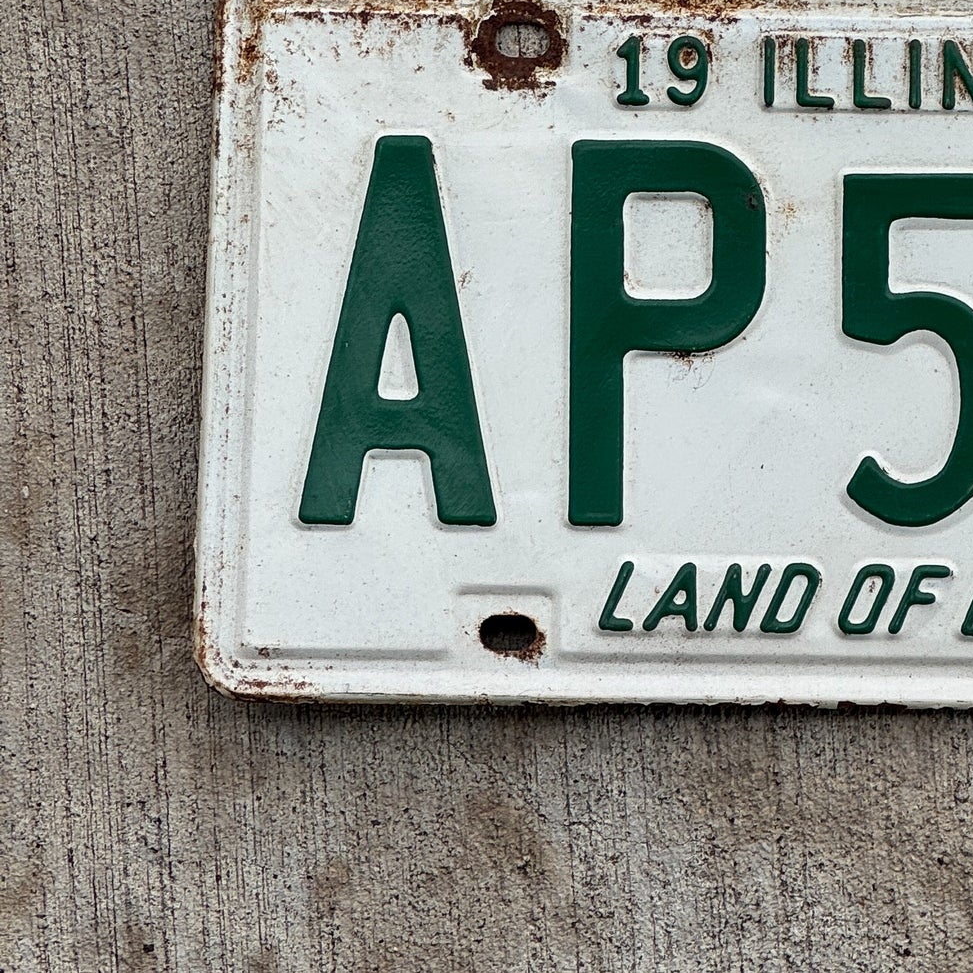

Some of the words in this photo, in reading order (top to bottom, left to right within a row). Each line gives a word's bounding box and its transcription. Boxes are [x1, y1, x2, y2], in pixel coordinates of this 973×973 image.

[616, 34, 709, 106] 19
[598, 559, 821, 634] LAND
[836, 562, 953, 635] OF
